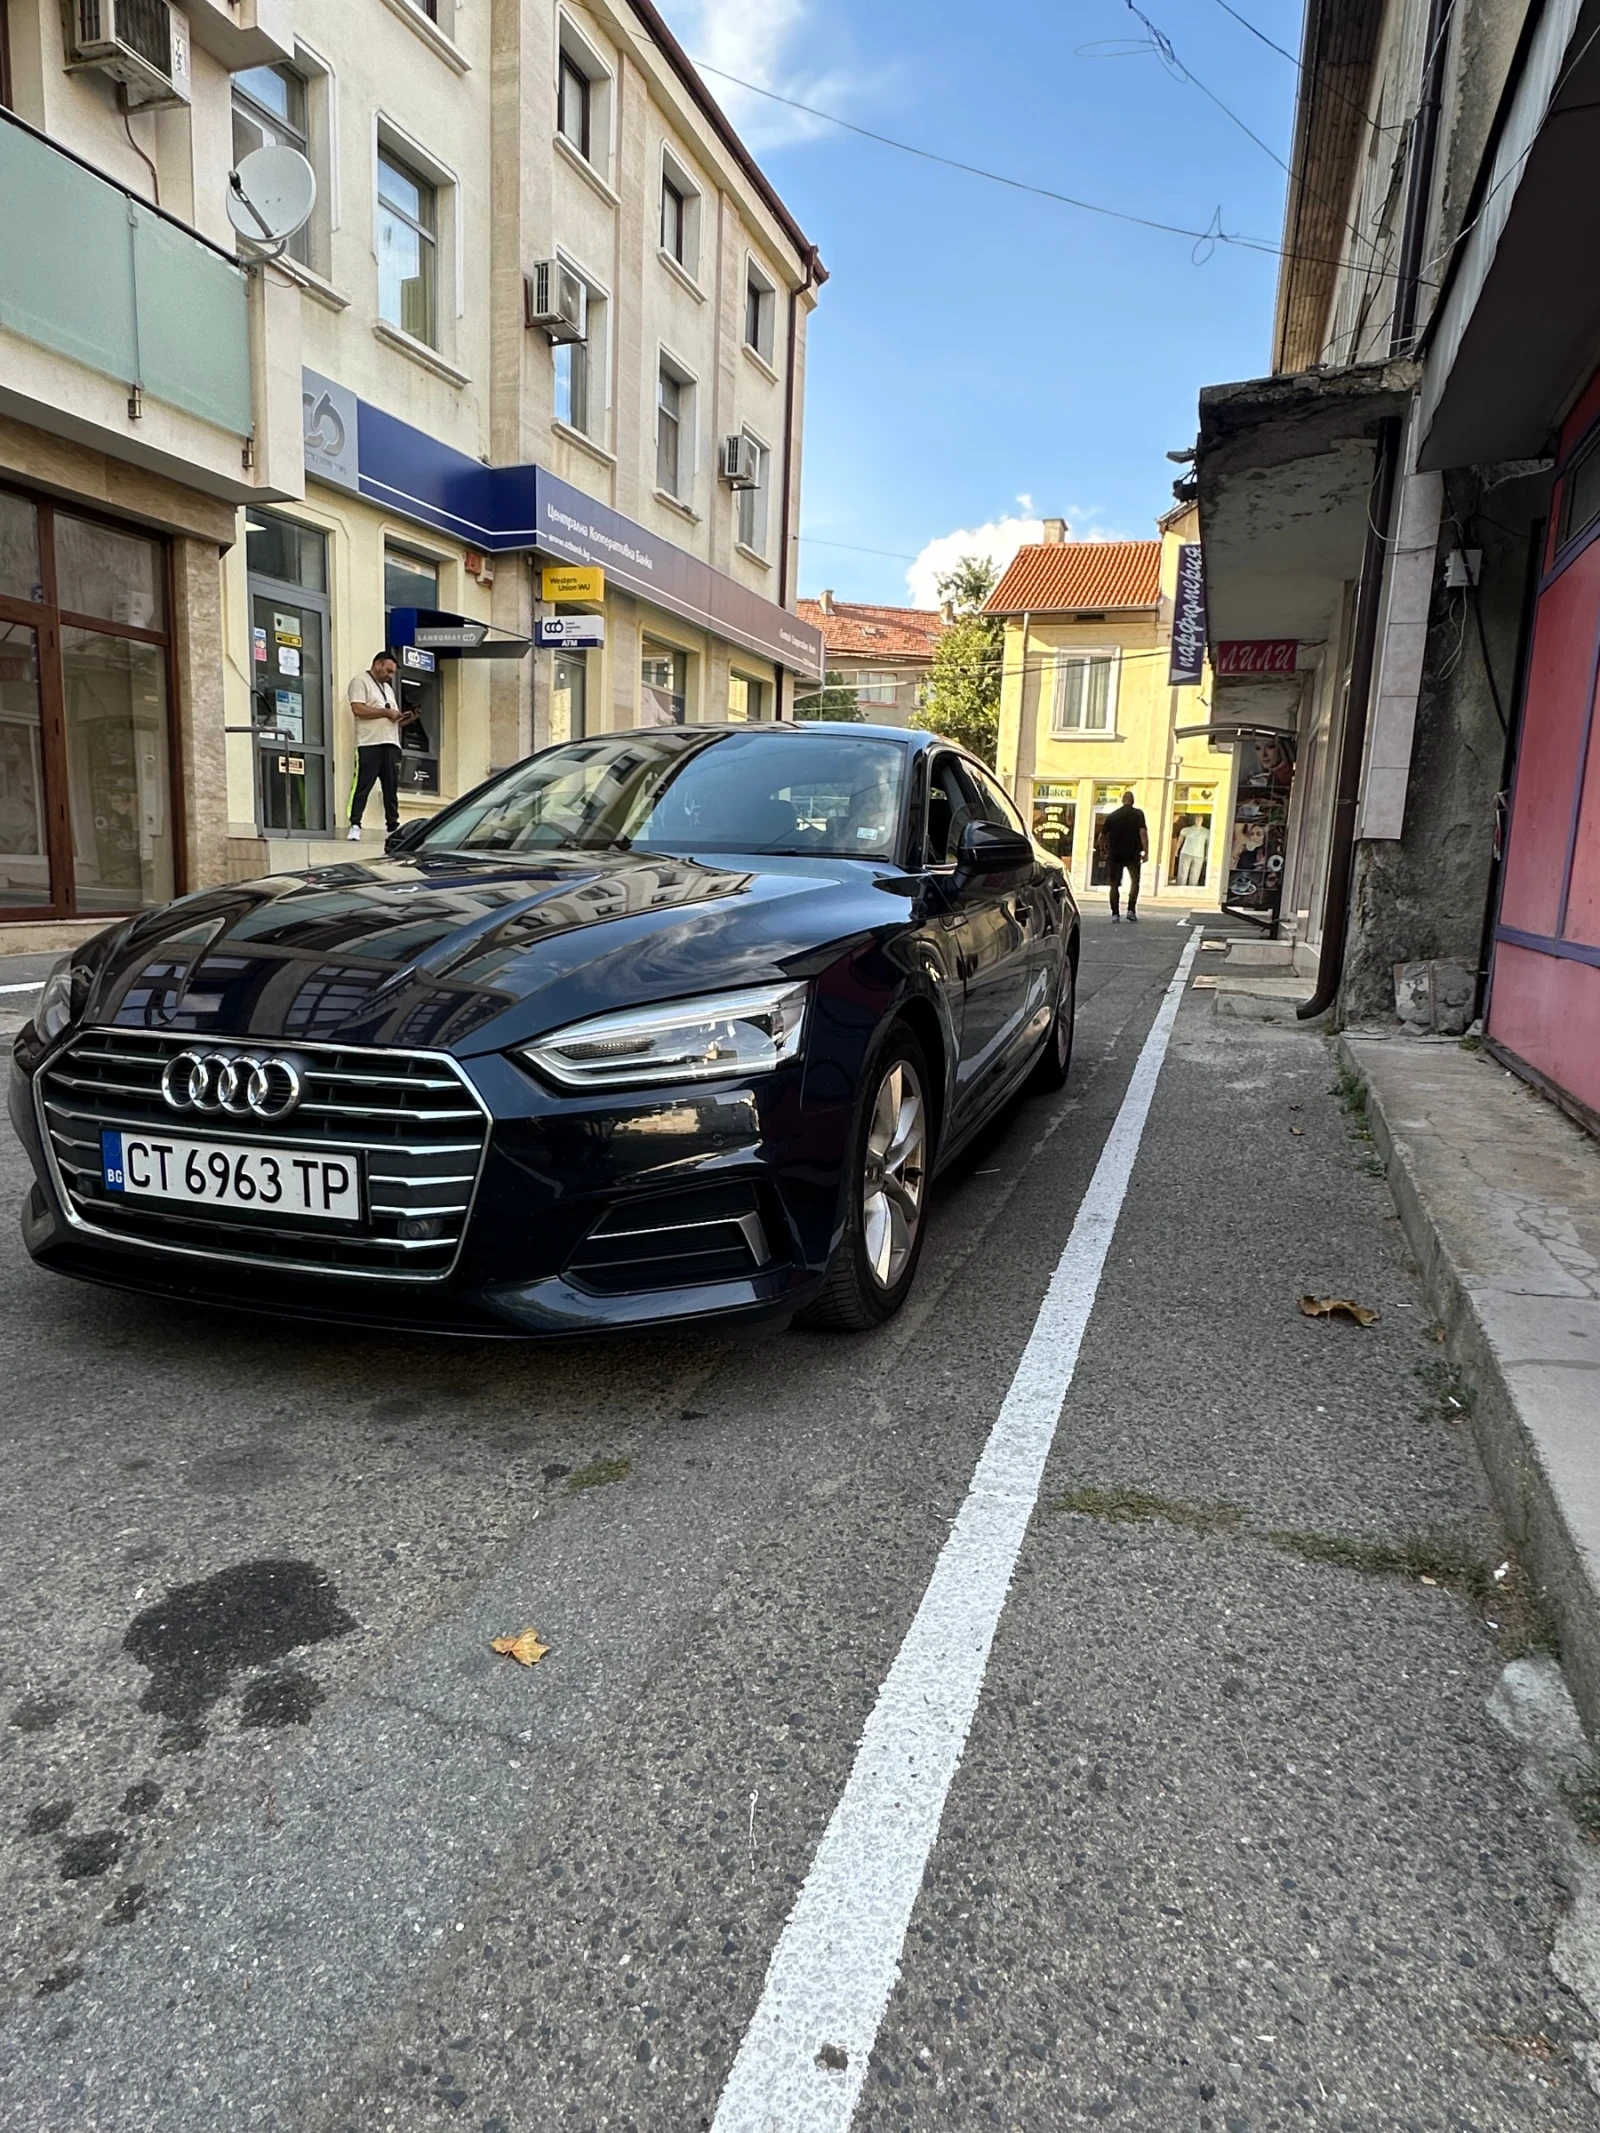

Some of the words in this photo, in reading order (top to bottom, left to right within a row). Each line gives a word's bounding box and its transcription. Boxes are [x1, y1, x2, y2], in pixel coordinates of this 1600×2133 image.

[547, 503, 588, 537] Централна
[589, 525, 635, 560] Кооперативна
[635, 550, 653, 569] Банка
[1173, 546, 1205, 668] парфюмерия
[107, 1168, 123, 1183] BG
[127, 1142, 173, 1191] CT
[184, 1149, 282, 1203] 6963
[292, 1159, 349, 1210] TP
